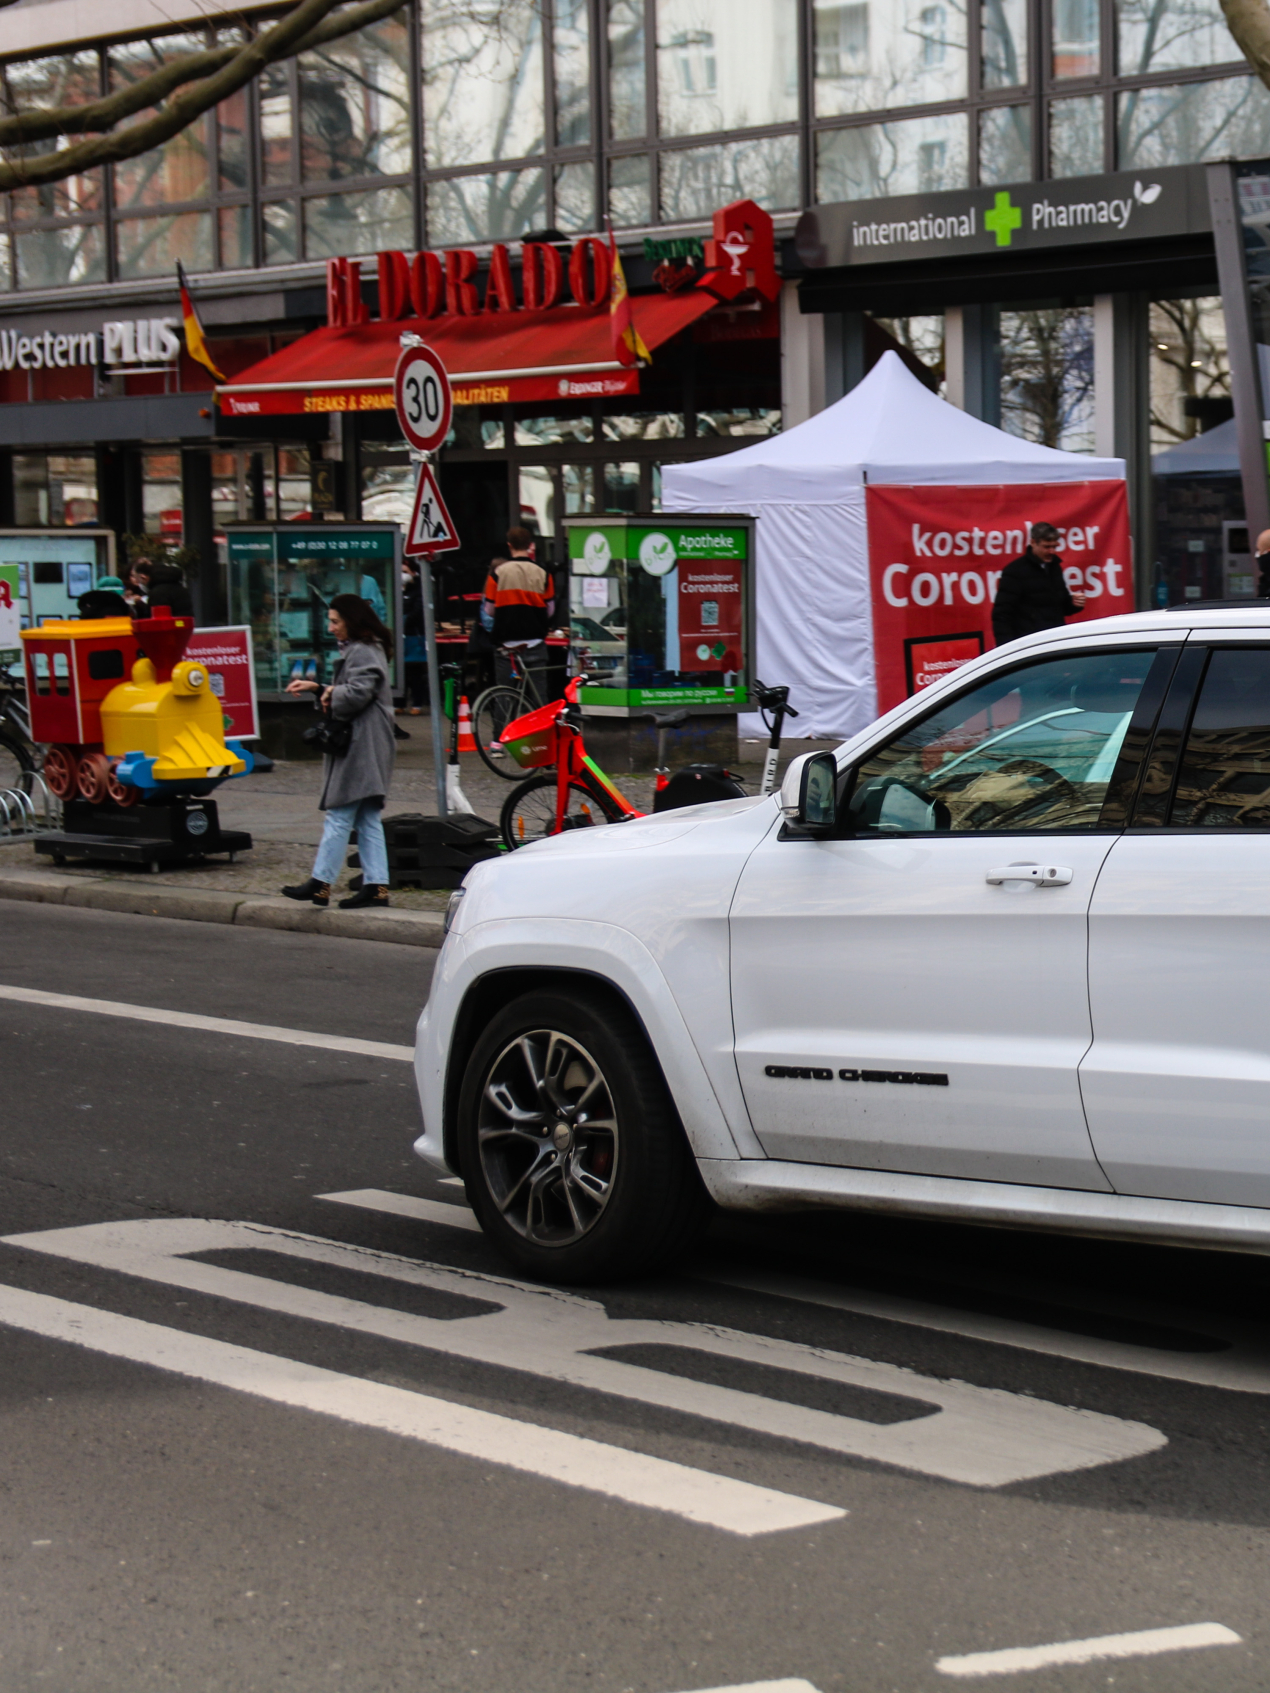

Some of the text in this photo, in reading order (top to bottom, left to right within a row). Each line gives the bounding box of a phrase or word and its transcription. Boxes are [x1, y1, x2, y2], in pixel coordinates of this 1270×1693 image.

[851, 197, 1133, 247] international Pharmacy
[326, 256, 370, 328] EL
[376, 237, 612, 321] DORADO
[103, 317, 181, 365] PLUS
[303, 396, 347, 412] STEAKS
[406, 374, 440, 424] 30
[678, 534, 734, 551] Apotheke
[911, 521, 1100, 557] kostenlser
[680, 582, 740, 593] Coronatest
[688, 573, 734, 582] kostenloser
[185, 646, 241, 656] kostenloser
[764, 1064, 949, 1087] GRAND CHEROKEE
